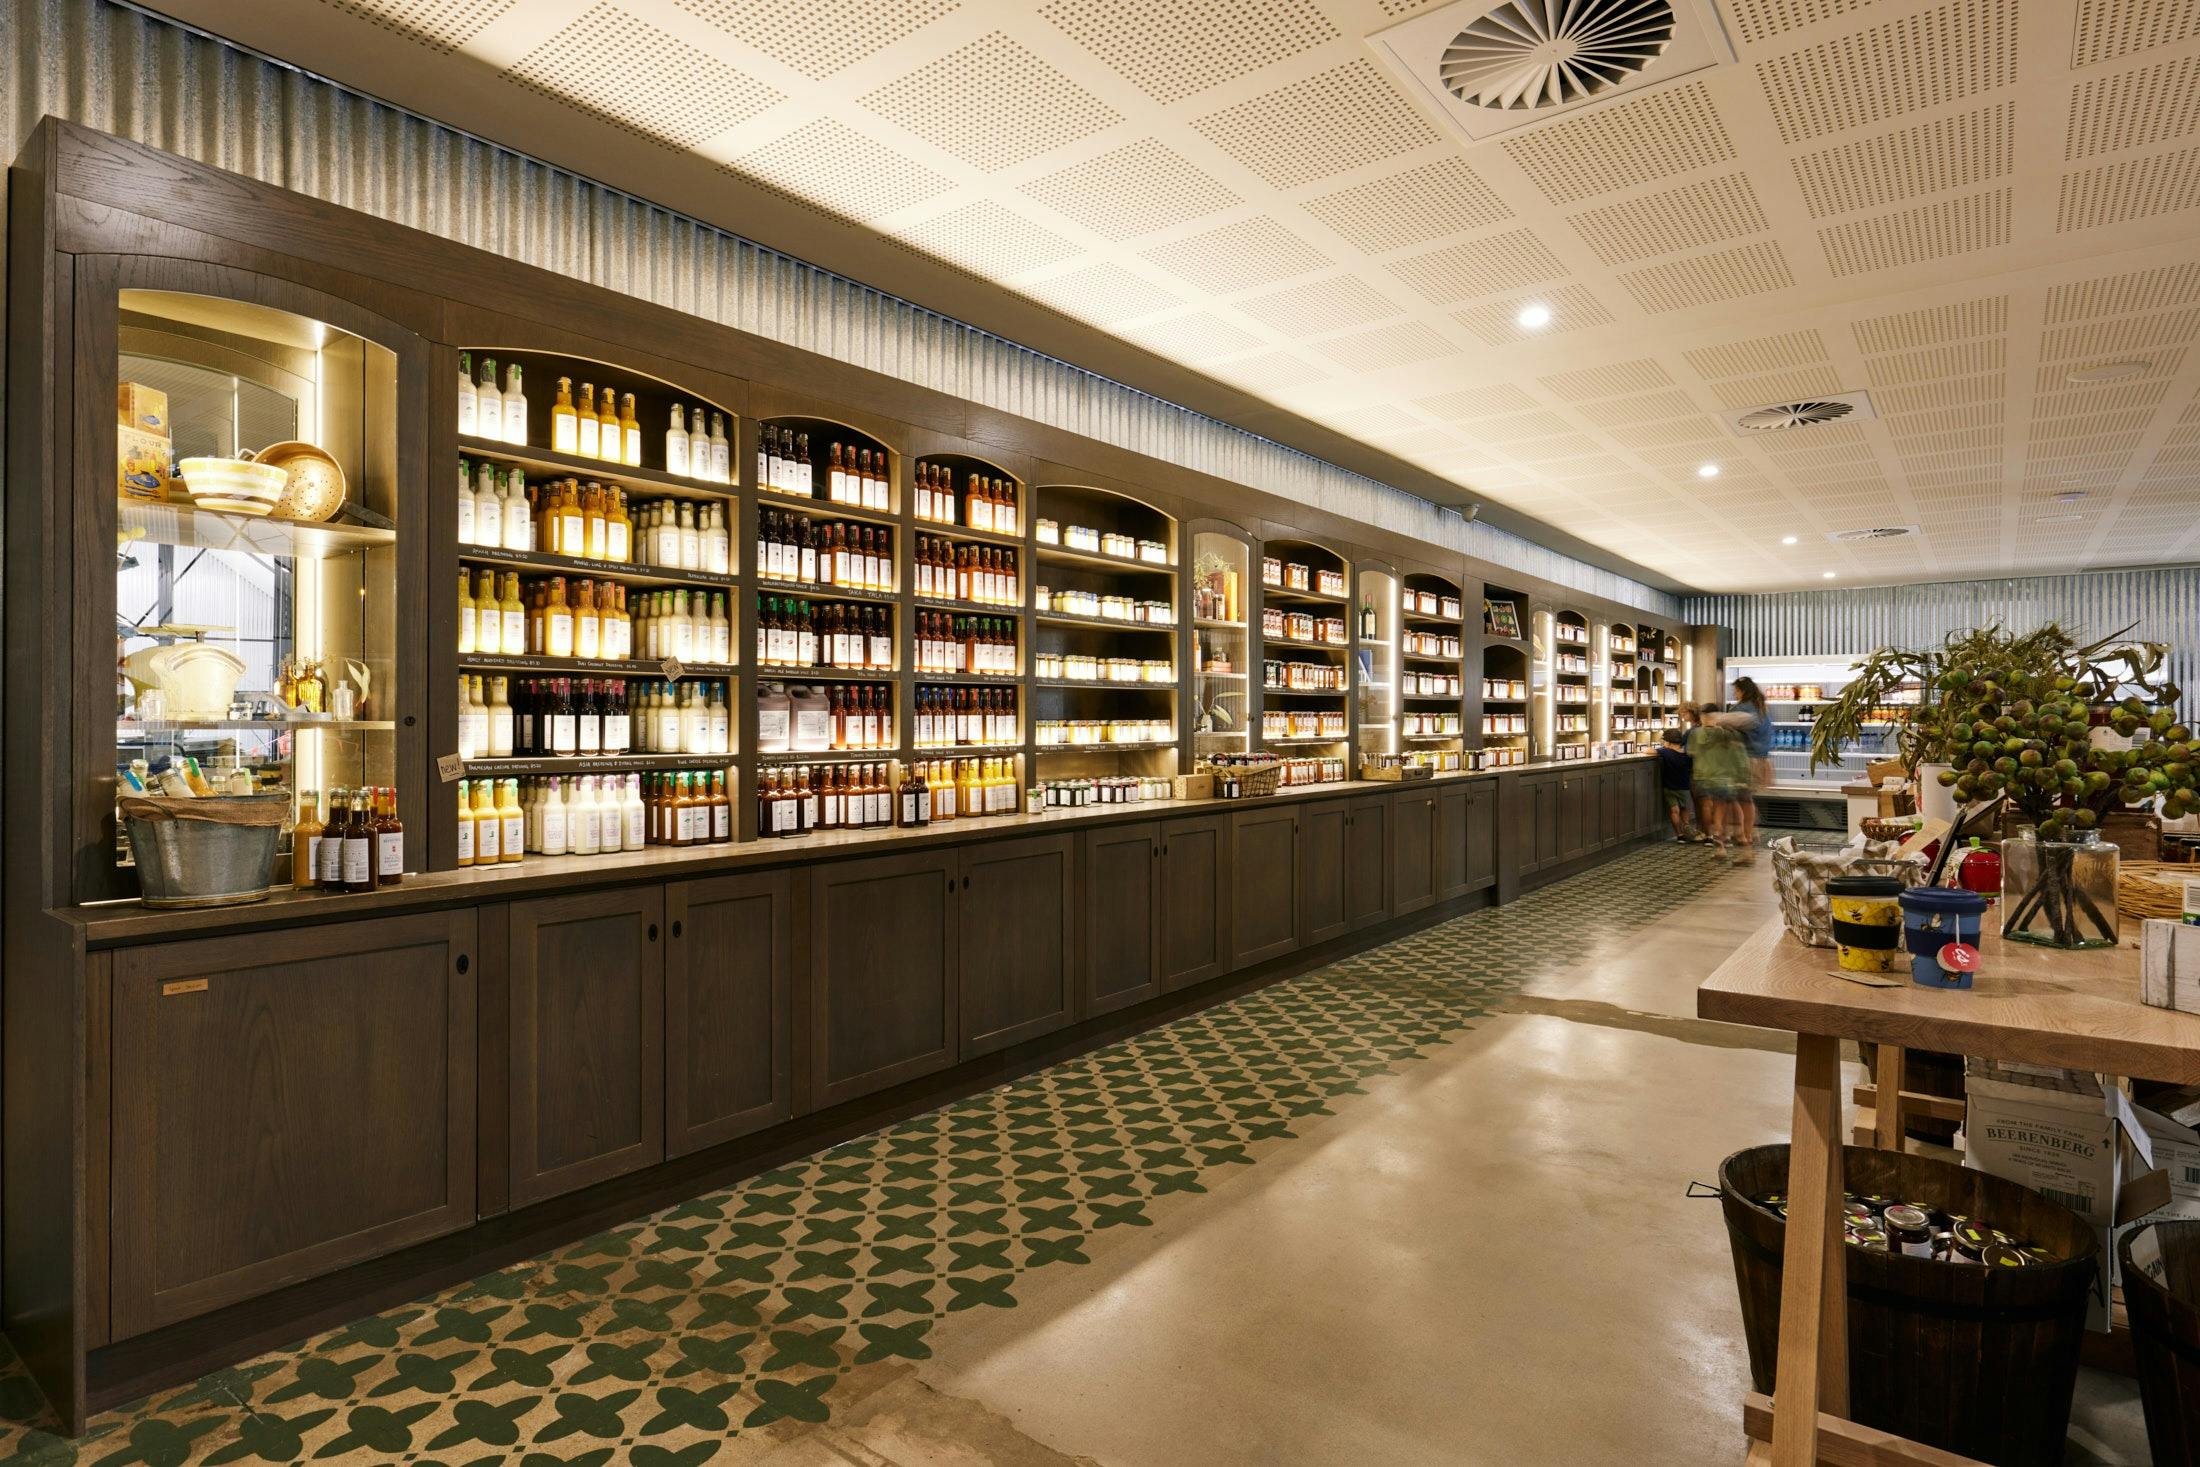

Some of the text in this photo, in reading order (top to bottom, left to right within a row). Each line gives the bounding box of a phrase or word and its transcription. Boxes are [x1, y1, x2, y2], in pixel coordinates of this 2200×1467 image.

[440, 758, 460, 774] new!
[2035, 1123, 2061, 1134] FAMILY
[2063, 1129, 2085, 1140] FARM
[1985, 1127, 2096, 1158] BEERENBERG
[2019, 1145, 2041, 1154] SINCE
